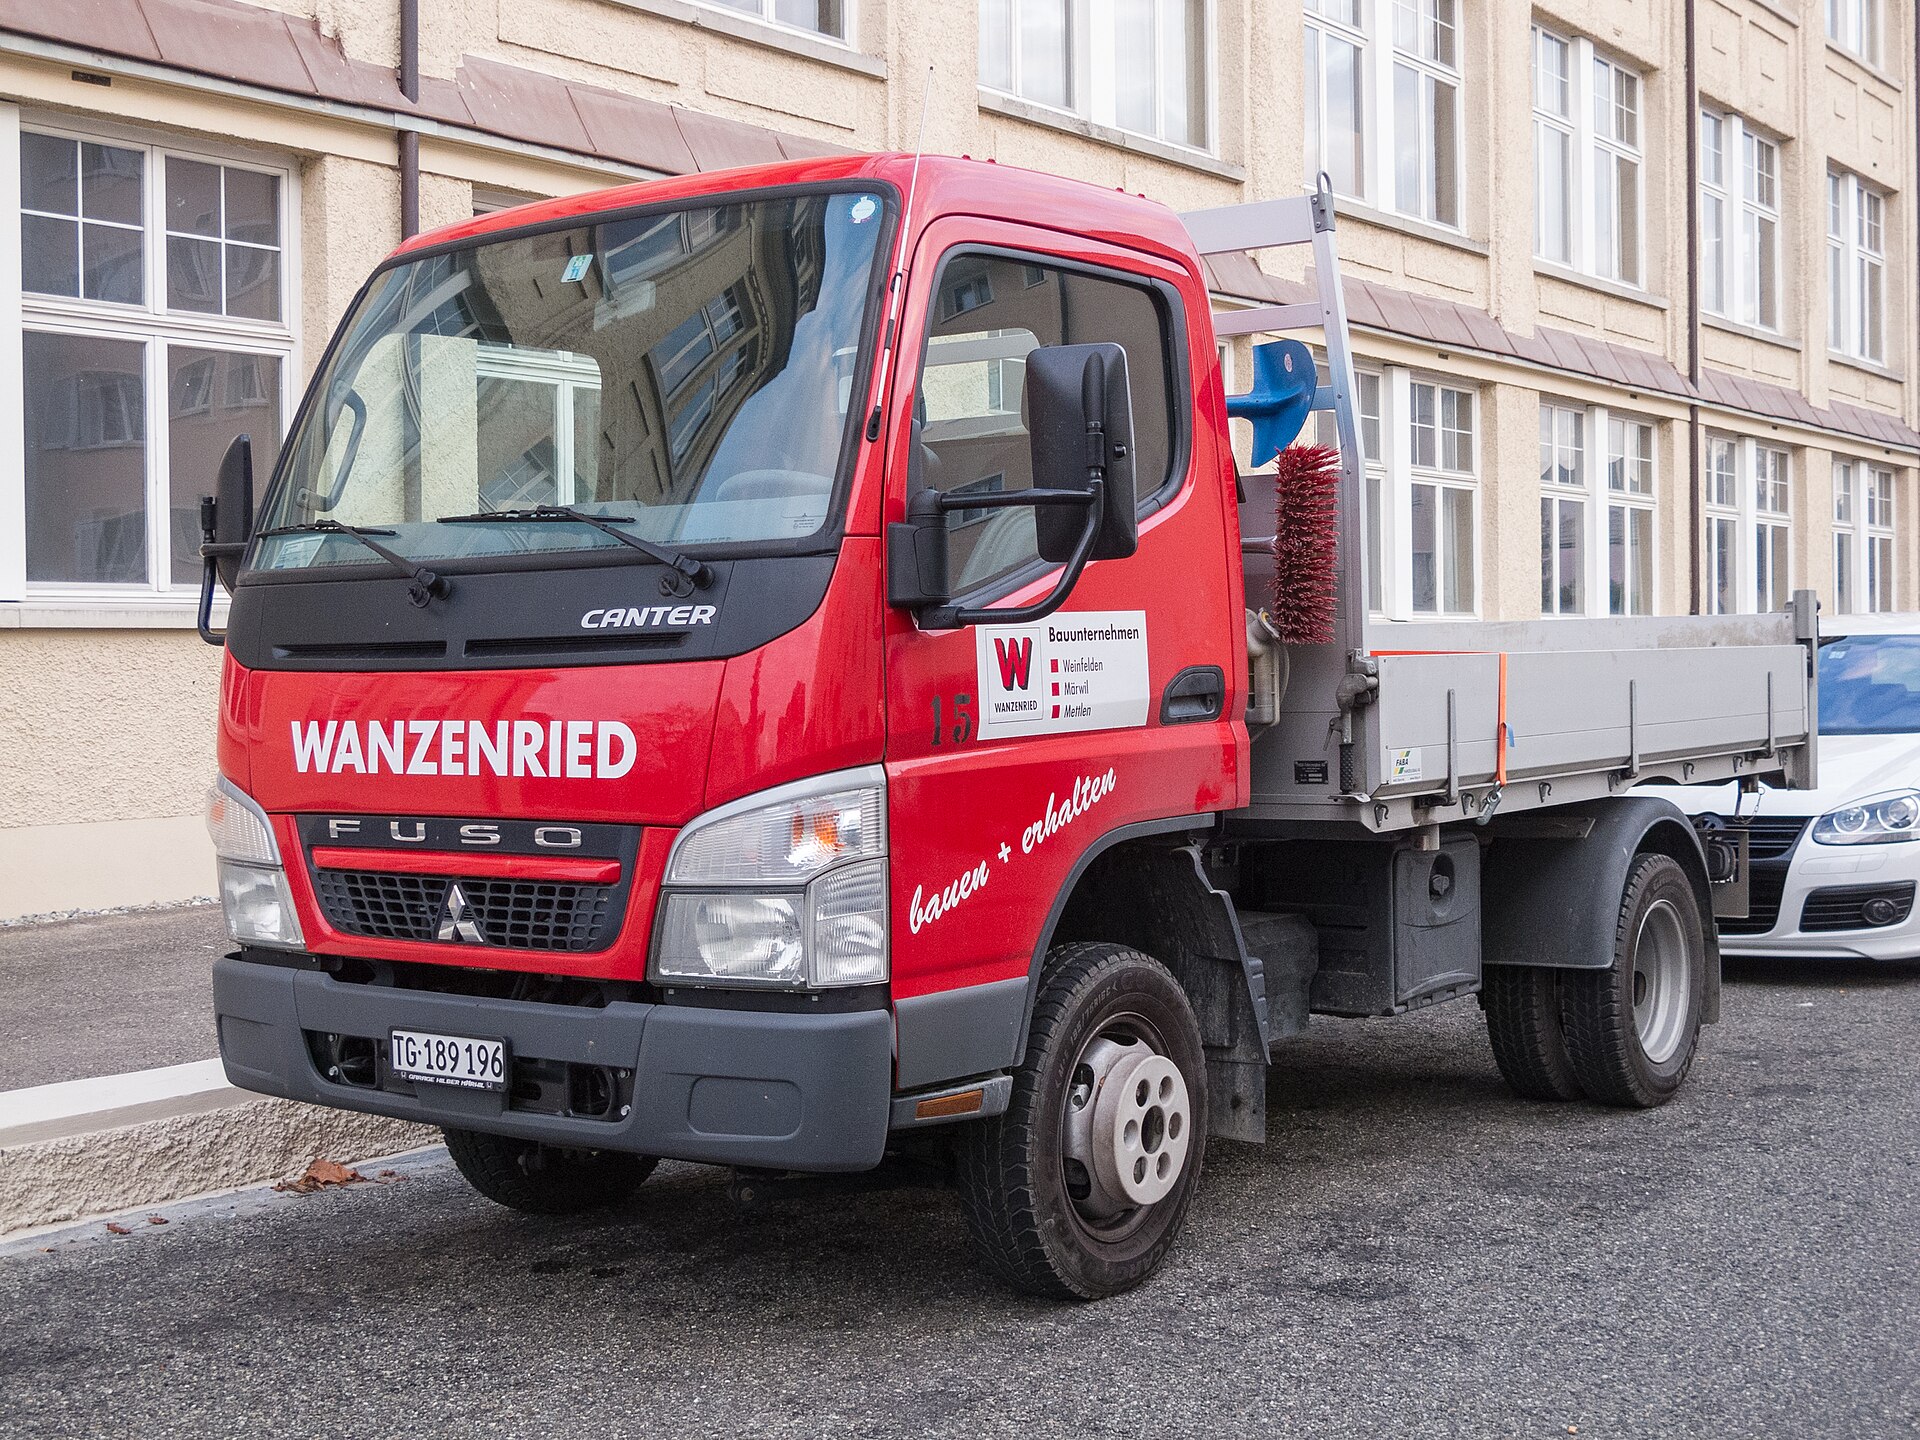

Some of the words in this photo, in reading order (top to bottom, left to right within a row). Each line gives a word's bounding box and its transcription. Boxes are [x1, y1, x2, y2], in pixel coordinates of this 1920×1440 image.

[581, 605, 717, 628] CANTER
[1049, 624, 1139, 642] Bauunternehmen
[994, 637, 1032, 691] W
[1063, 657, 1104, 672] Weinfelden
[1064, 680, 1089, 696] Märwil
[994, 700, 1038, 713] WANZENRIED
[1064, 703, 1092, 718] Mettlen
[931, 694, 971, 746] 15
[291, 720, 637, 779] WANZENRIED
[329, 819, 582, 848] FUSO
[909, 860, 990, 934] bauen
[1022, 767, 1117, 854] erhalten
[465, 1043, 503, 1078] 196
[408, 1074, 435, 1083] GARAGE
